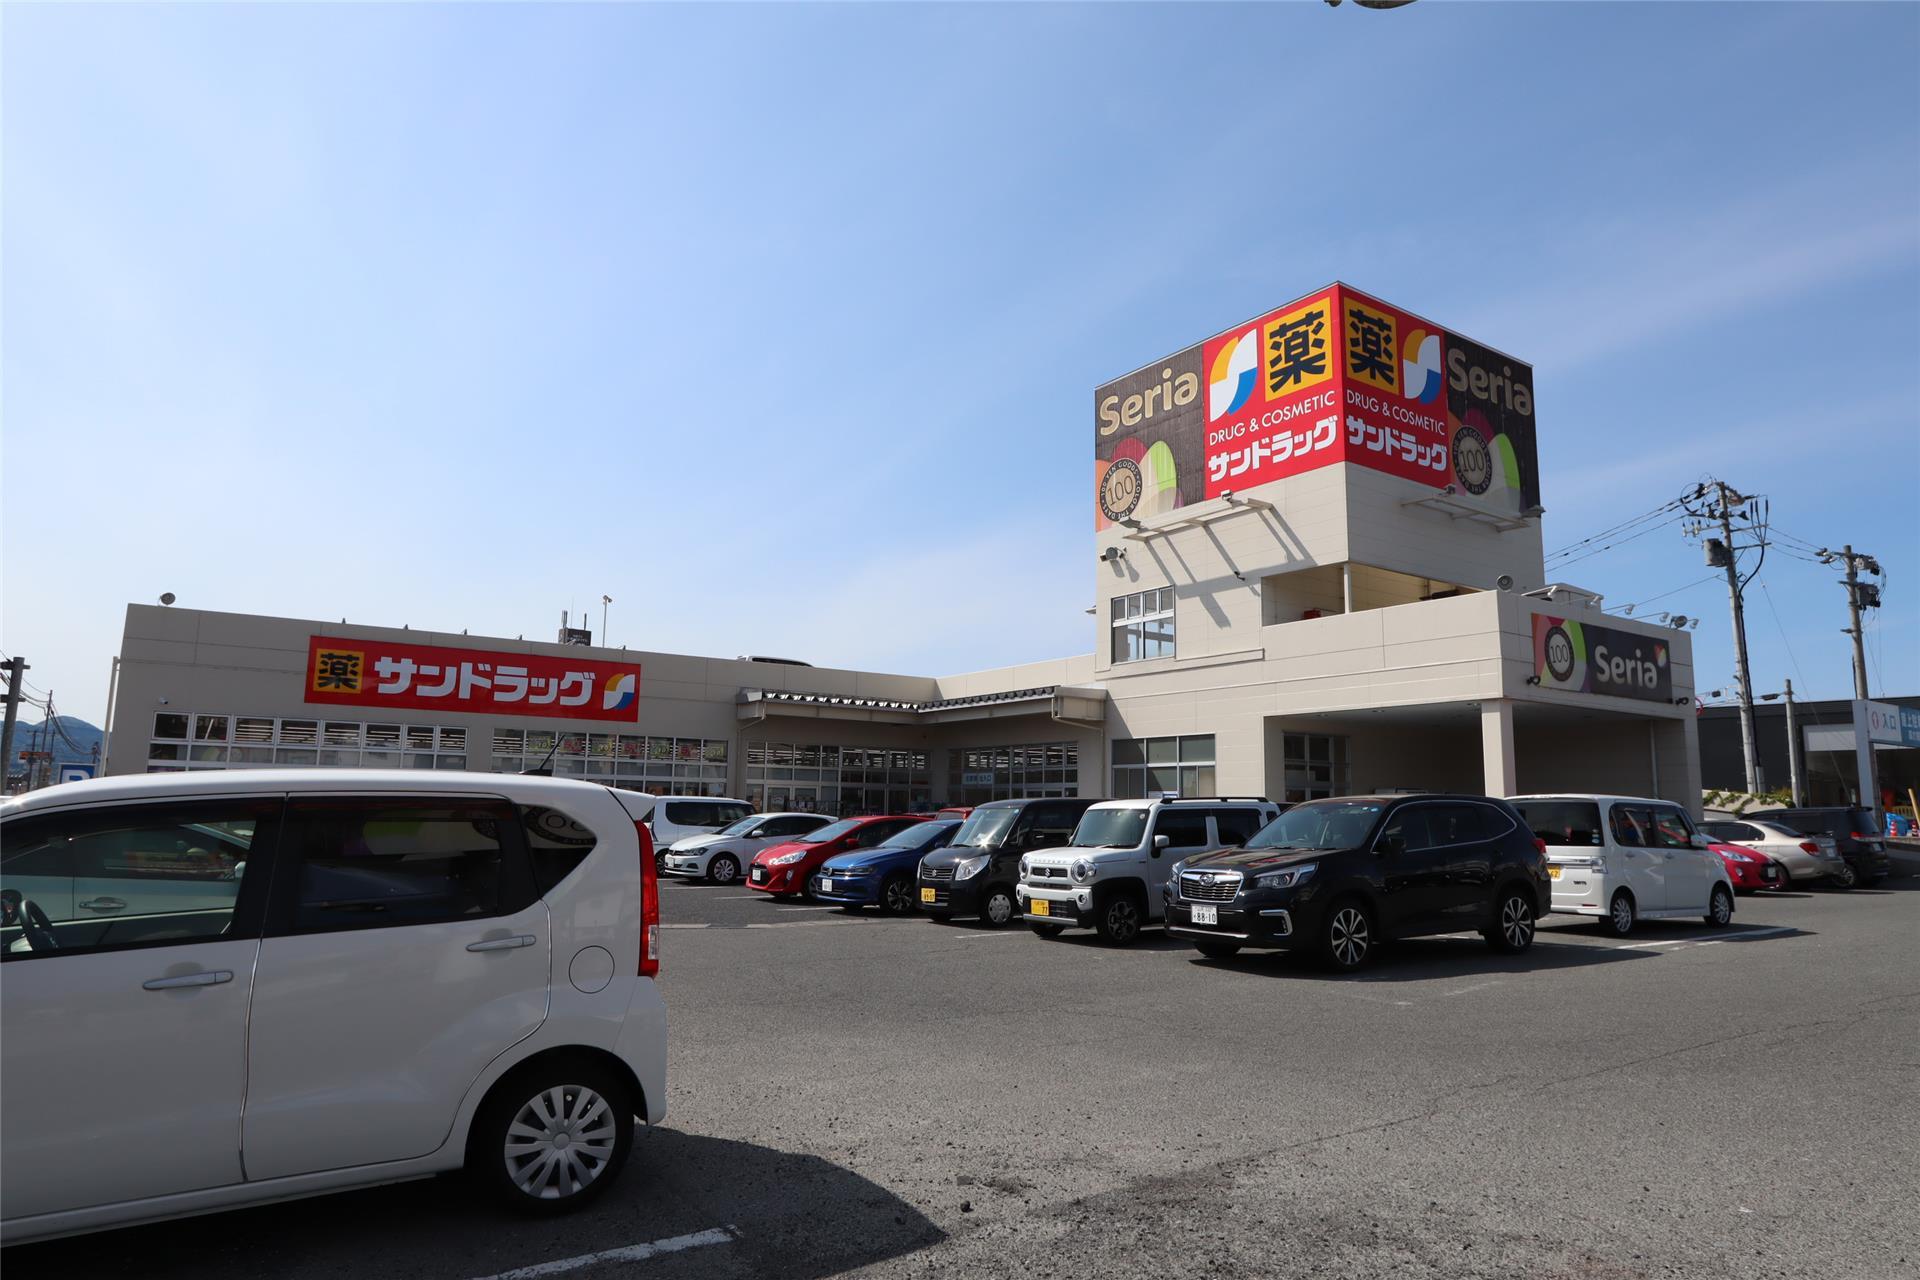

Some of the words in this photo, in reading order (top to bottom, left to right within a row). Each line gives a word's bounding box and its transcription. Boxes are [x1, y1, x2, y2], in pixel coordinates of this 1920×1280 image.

[1269, 310, 1326, 393] 薬
[1349, 309, 1394, 386] 薬
[1100, 367, 1198, 436] Seria
[1447, 348, 1532, 416] Seria
[1209, 422, 1246, 446] DRUG
[1249, 418, 1259, 432] &
[1261, 390, 1335, 427] COSMETIC
[1346, 389, 1379, 413] DRUG
[1382, 402, 1390, 417] &
[1392, 406, 1446, 436] COSMETIC
[1208, 414, 1338, 482] サンドラッグ
[1346, 415, 1448, 472] サンドラッグ
[1460, 449, 1485, 472] 100
[1107, 475, 1134, 506] 100
[318, 652, 358, 690] 薬
[374, 656, 596, 706] サンドラッグ
[1550, 644, 1569, 664] 100
[1594, 645, 1657, 689] Seria
